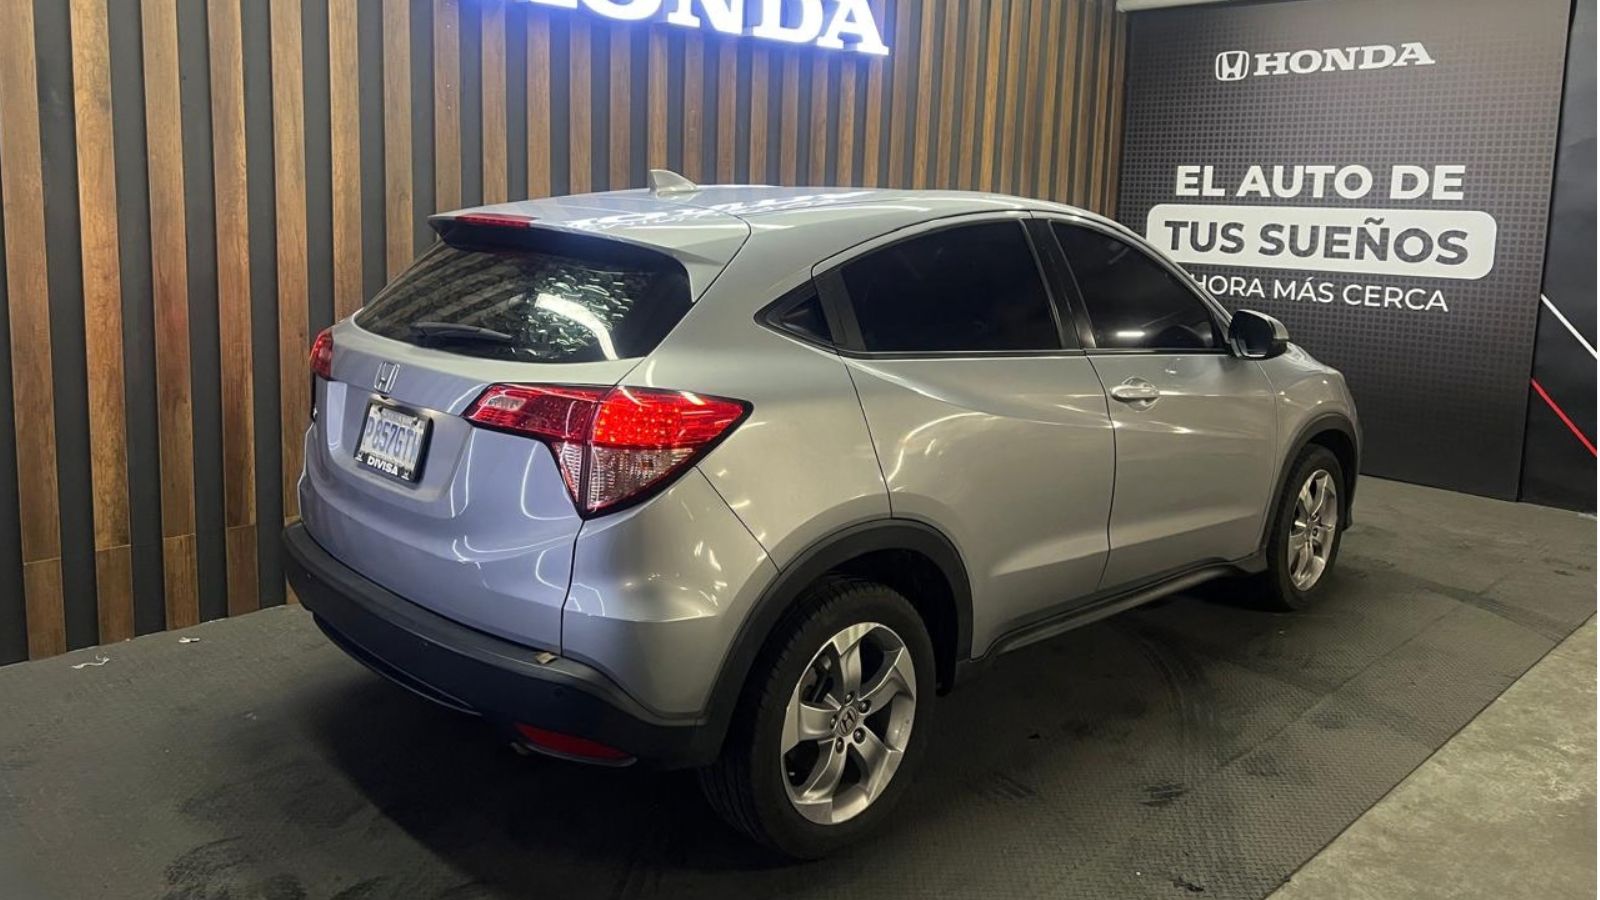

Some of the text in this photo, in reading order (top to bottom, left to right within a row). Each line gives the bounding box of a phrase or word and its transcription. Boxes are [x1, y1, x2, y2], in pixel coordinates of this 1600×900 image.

[526, 0, 889, 56] NDA
[1253, 42, 1436, 76] HONDA
[1175, 164, 1466, 200] EL AUTO DE
[1164, 217, 1469, 266] TUS SUEÑOS
[1190, 273, 1449, 313] HORA MÁS CERCA
[367, 455, 398, 476] DIVISA
